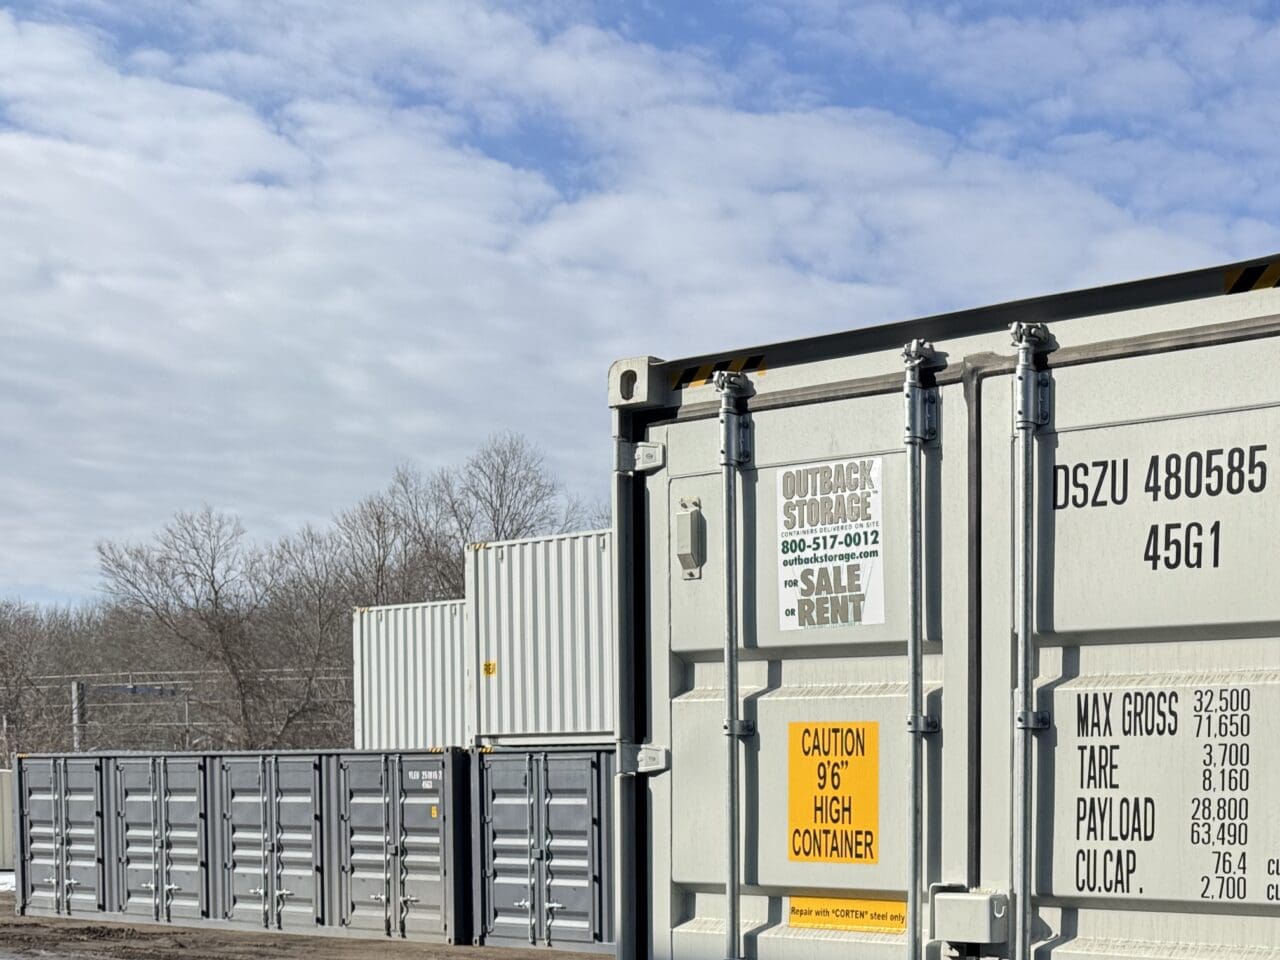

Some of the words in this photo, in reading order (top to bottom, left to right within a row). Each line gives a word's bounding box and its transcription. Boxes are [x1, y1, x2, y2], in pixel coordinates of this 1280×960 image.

[782, 460, 875, 500] OUTBACK
[1052, 458, 1128, 510] DSZU
[1144, 444, 1267, 502] 480585
[783, 491, 872, 530] STORAGE
[781, 528, 817, 538] CONTAINERS
[819, 524, 852, 533] DELIVERED
[781, 530, 879, 554] 800-517-0012
[782, 550, 879, 567] outbackstorage.com
[1144, 520, 1221, 571] 45G1
[784, 579, 798, 588] FOR
[800, 564, 861, 597] SALE
[785, 608, 796, 617] OR
[797, 594, 865, 626] RENT
[1076, 692, 1113, 737] MAX
[1121, 690, 1179, 737] GROSS
[1193, 688, 1251, 713] 32,500
[1194, 713, 1251, 738] 71,650
[801, 727, 865, 757] CAUTION
[1202, 742, 1250, 768] 3,700
[1077, 744, 1120, 790] TARE
[1202, 768, 1249, 793] 8,160
[814, 795, 852, 825] HIGH
[1076, 797, 1155, 841] PAYLOAD
[1191, 797, 1248, 822] 28,800
[792, 828, 874, 859] CONTAINER
[1190, 822, 1248, 846] 63,490
[1211, 851, 1247, 875] 76.4
[1200, 876, 1247, 900] 2,700
[791, 906, 813, 917] Repair
[815, 908, 829, 917] with
[870, 912, 887, 921] steel
[890, 913, 905, 924] only
